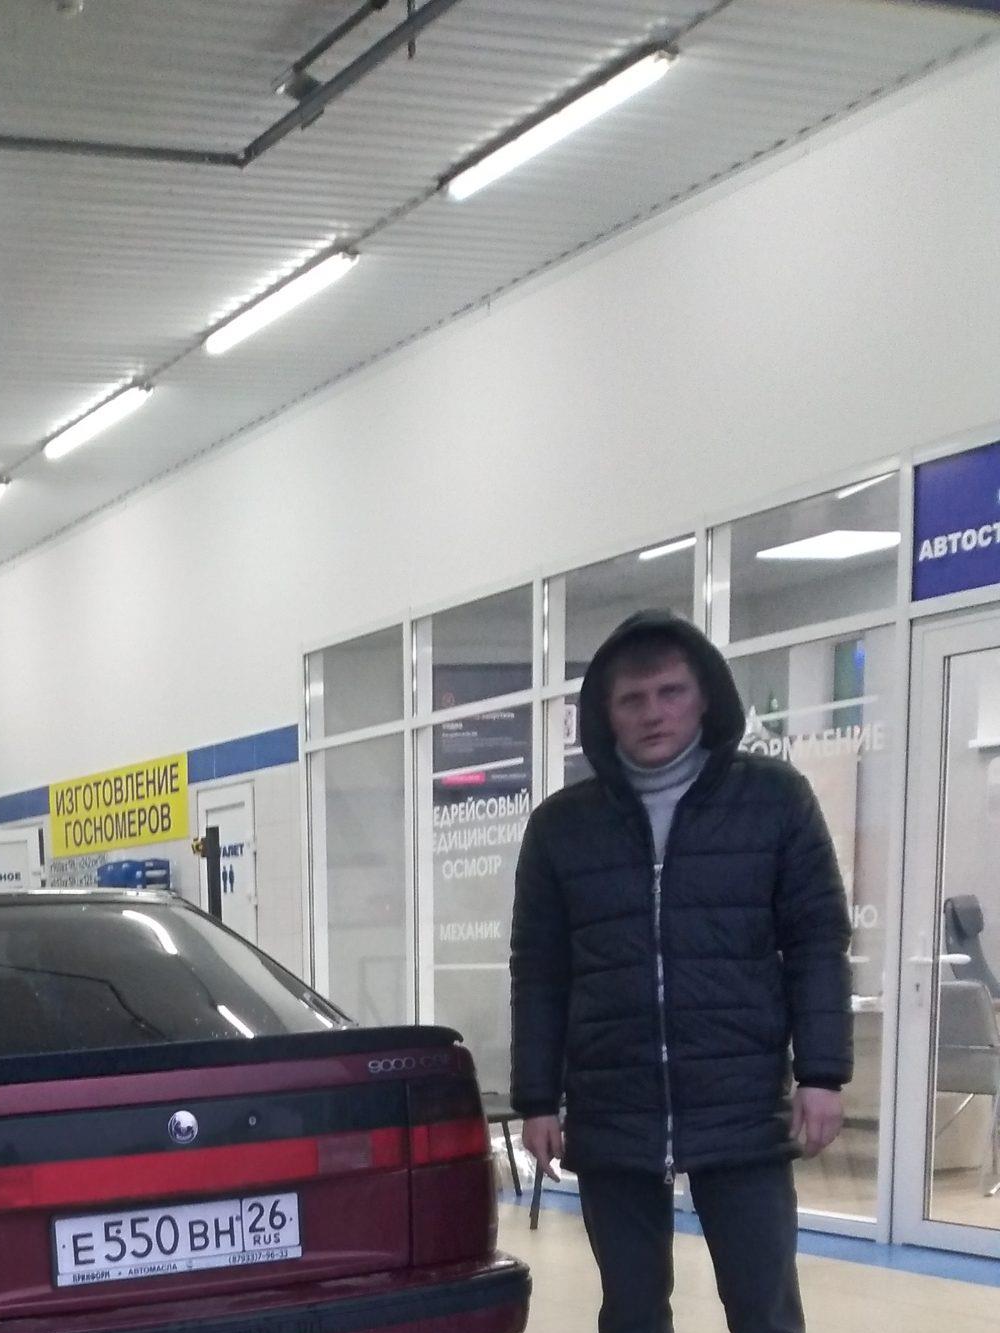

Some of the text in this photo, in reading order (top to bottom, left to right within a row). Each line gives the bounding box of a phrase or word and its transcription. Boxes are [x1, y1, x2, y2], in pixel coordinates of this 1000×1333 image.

[737, 723, 886, 762] ОРМЛЕНИЕ
[55, 762, 180, 817] ИЗГОТОВЛЕНИЕ
[433, 788, 530, 828] ЕДРЕЙСОВЫЙ
[64, 803, 172, 848] ГОСНОМЕРОВ
[220, 843, 244, 857] АЛЕТ
[442, 855, 502, 880] ОСМОТР
[440, 920, 501, 941] МЕХАНИК
[368, 1057, 415, 1073] 9000
[248, 1200, 287, 1234] 26
[253, 1233, 281, 1246] RUS
[128, 1263, 178, 1277] АВТОМАСЛА
